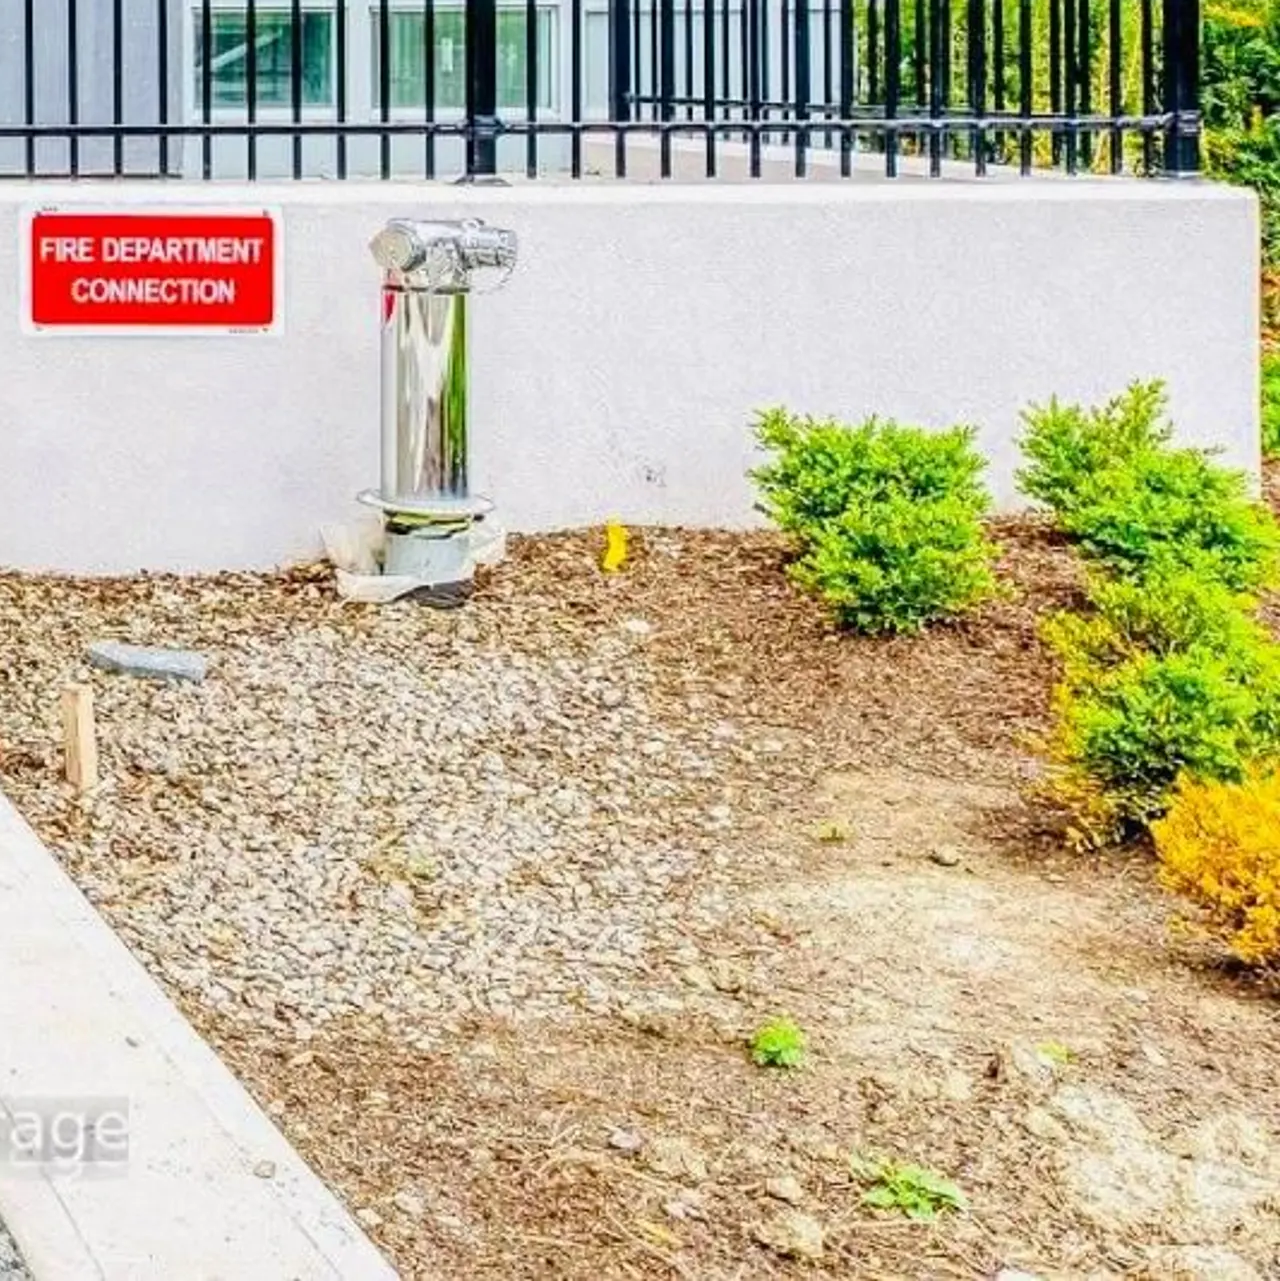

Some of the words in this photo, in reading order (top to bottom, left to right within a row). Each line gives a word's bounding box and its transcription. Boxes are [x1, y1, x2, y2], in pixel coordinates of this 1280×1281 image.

[40, 237, 95, 263] FIRE
[102, 236, 264, 263] DEPARTMENT
[71, 277, 236, 304] CONNECTION
